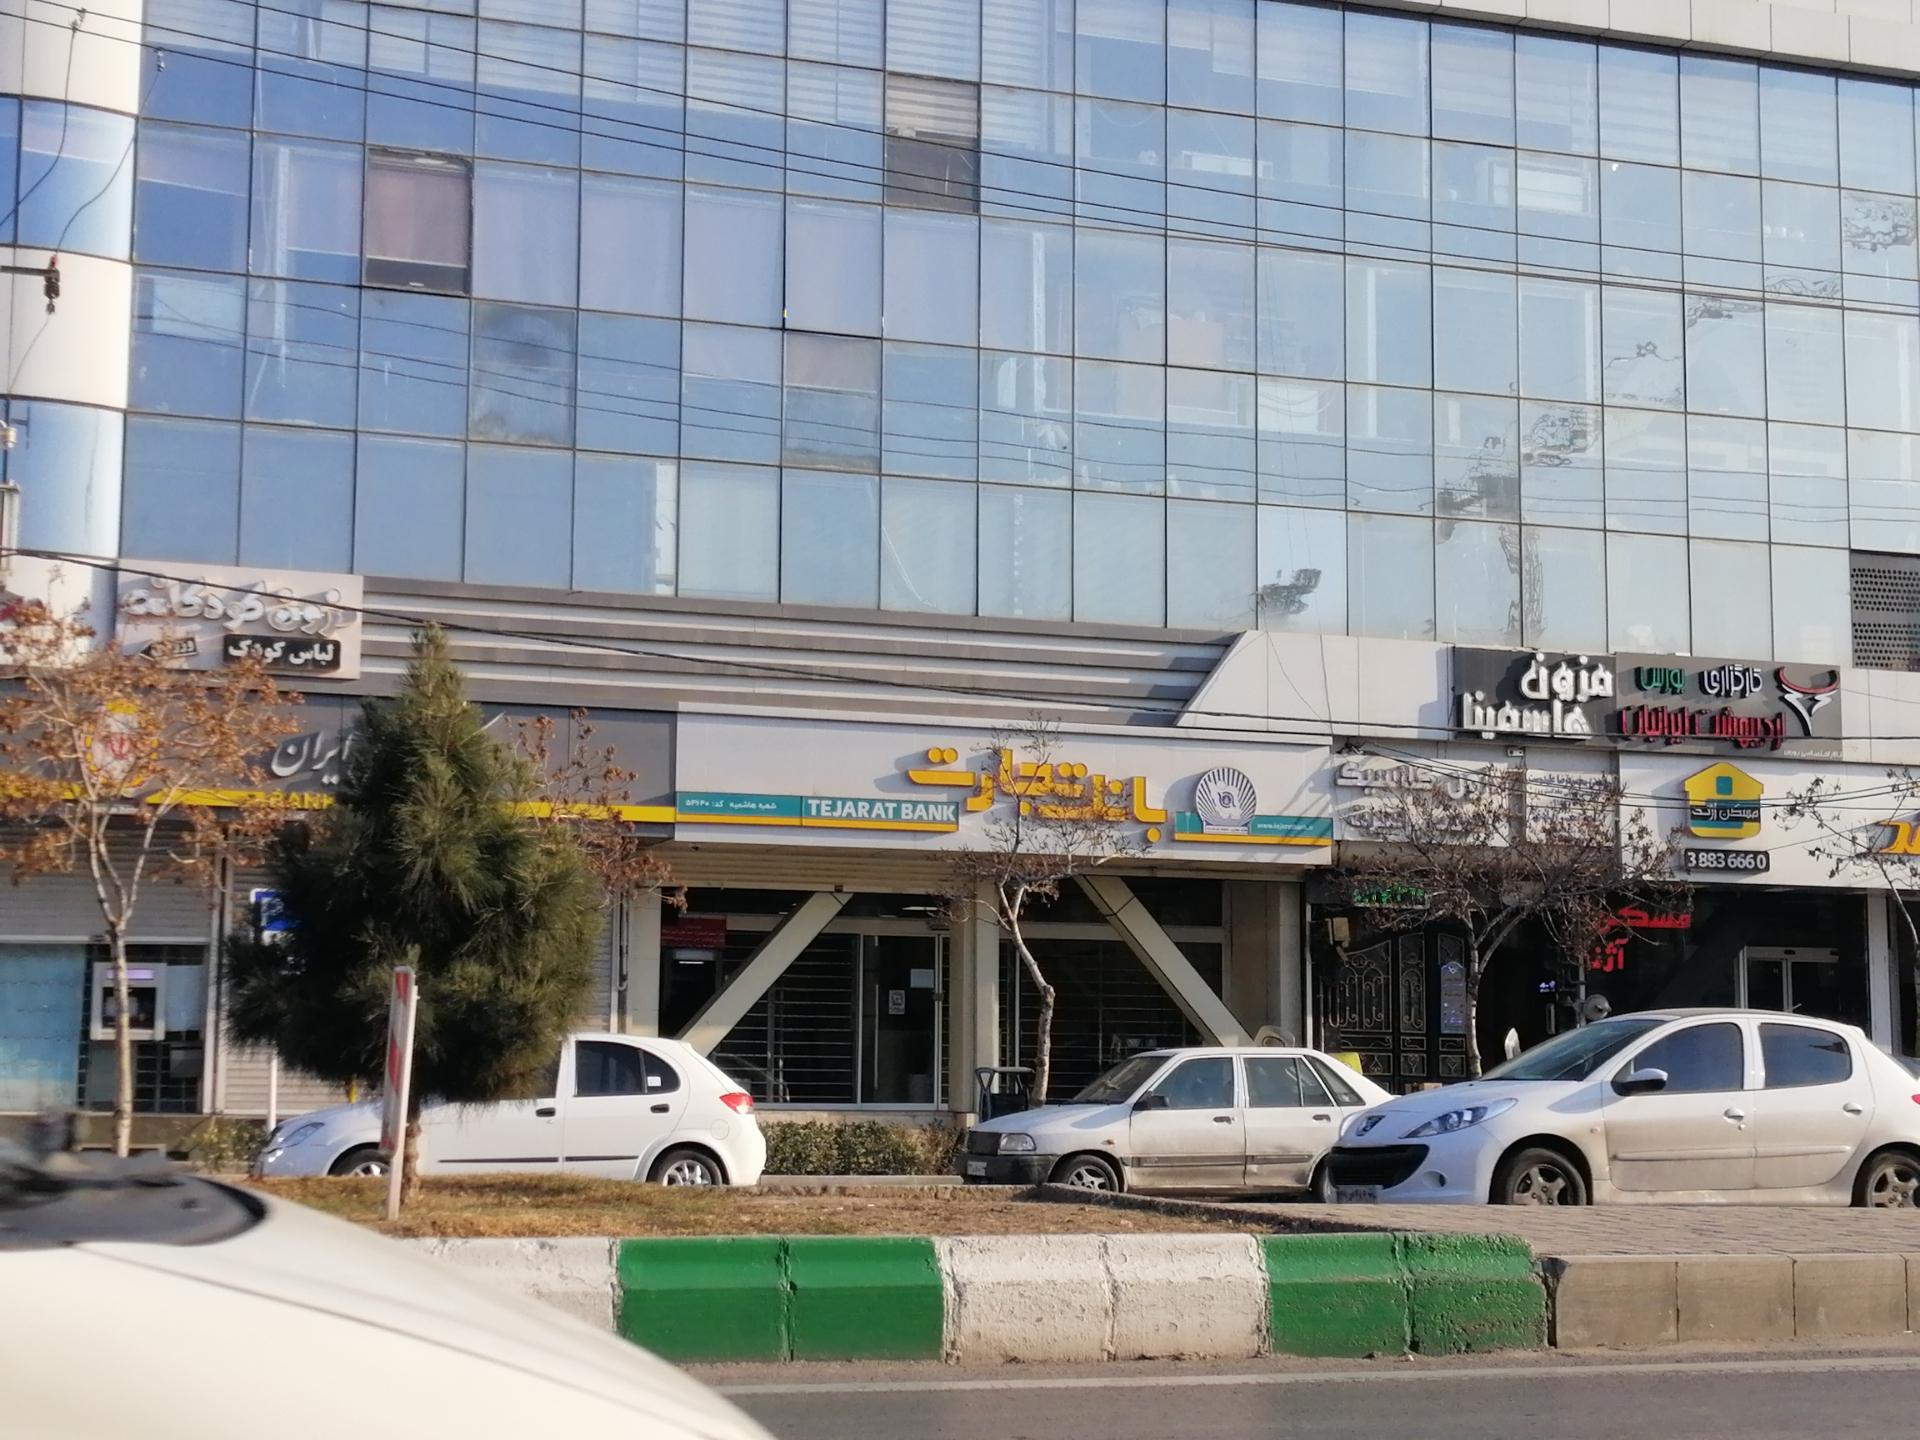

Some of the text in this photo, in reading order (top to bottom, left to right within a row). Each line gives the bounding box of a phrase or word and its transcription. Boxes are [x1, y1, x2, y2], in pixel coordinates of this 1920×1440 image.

[288, 642, 335, 666] لباس
[1520, 652, 1614, 702] مزون
[1637, 664, 1764, 697] کارگزاری بورس
[271, 729, 355, 785] ایران
[807, 798, 957, 822] TEJARAT BANK
[907, 746, 1168, 843] بانک تجارت
[1718, 803, 1759, 821] مسکن
